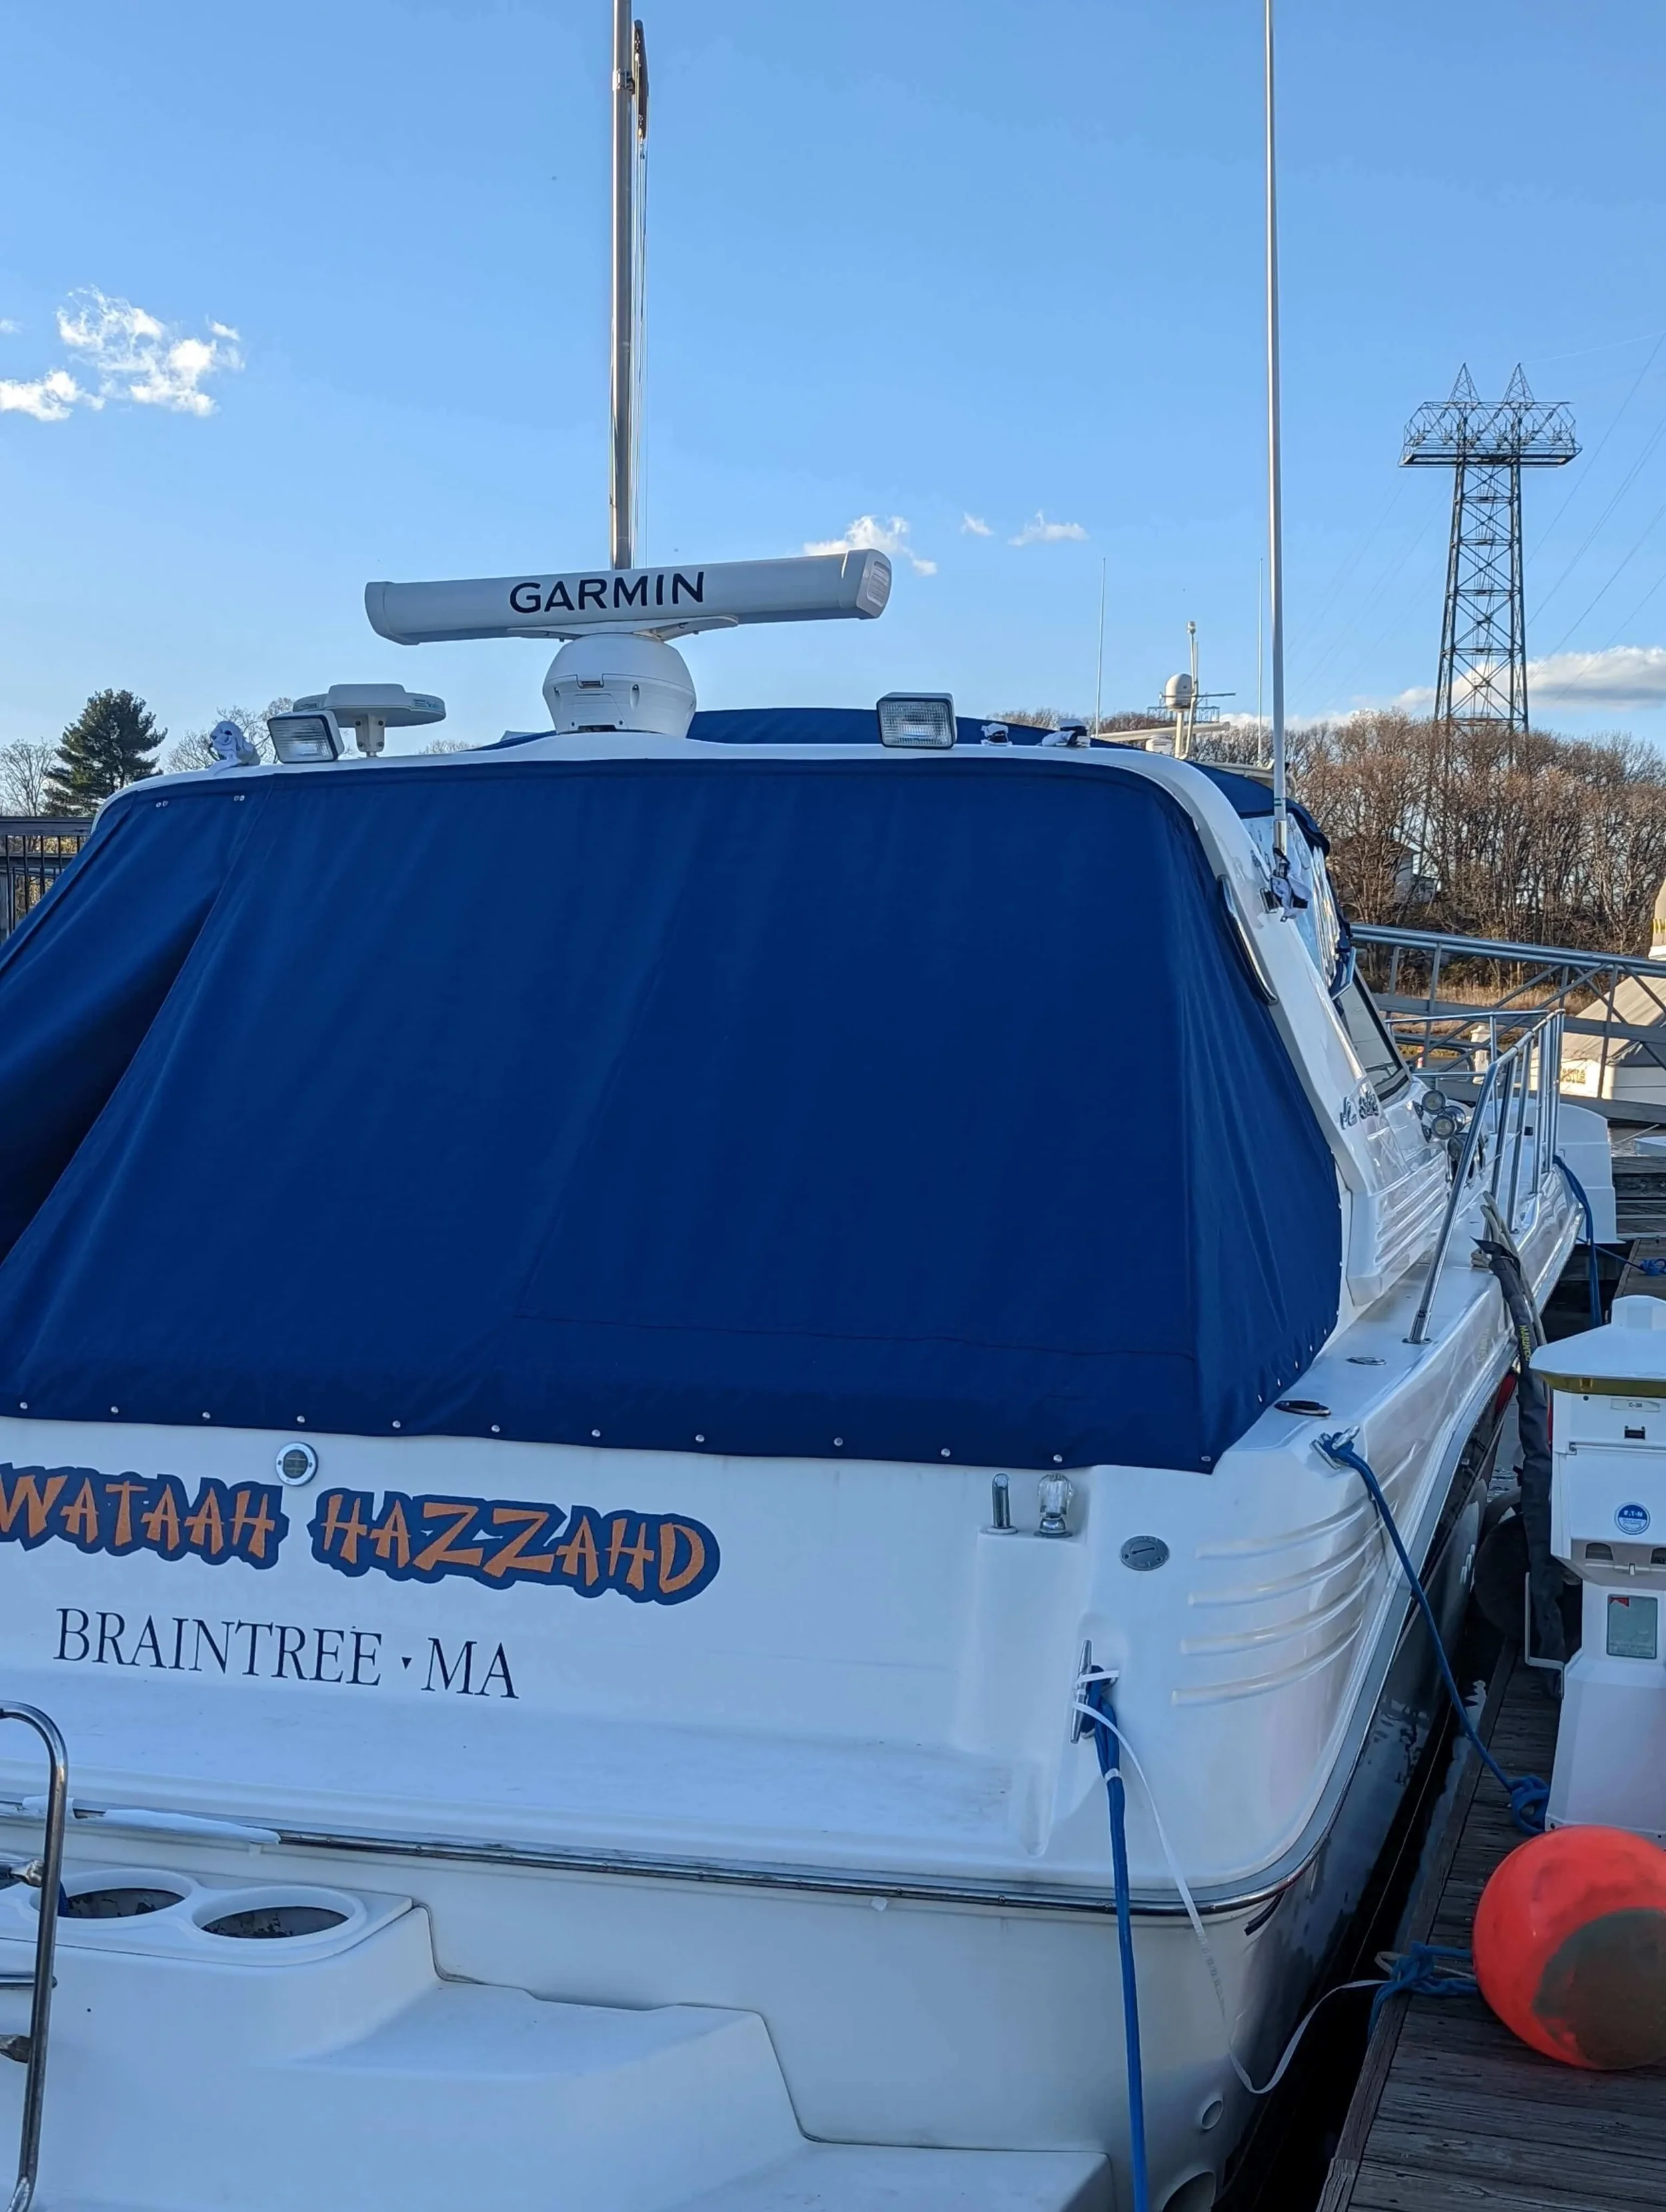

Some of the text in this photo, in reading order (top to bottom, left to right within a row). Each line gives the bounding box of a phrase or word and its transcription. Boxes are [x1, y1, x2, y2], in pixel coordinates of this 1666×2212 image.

[509, 571, 704, 614] GARMIN
[0, 1471, 711, 1597] WATAAH HAZZAHD
[53, 1608, 520, 1700] BRAINTREE MA
